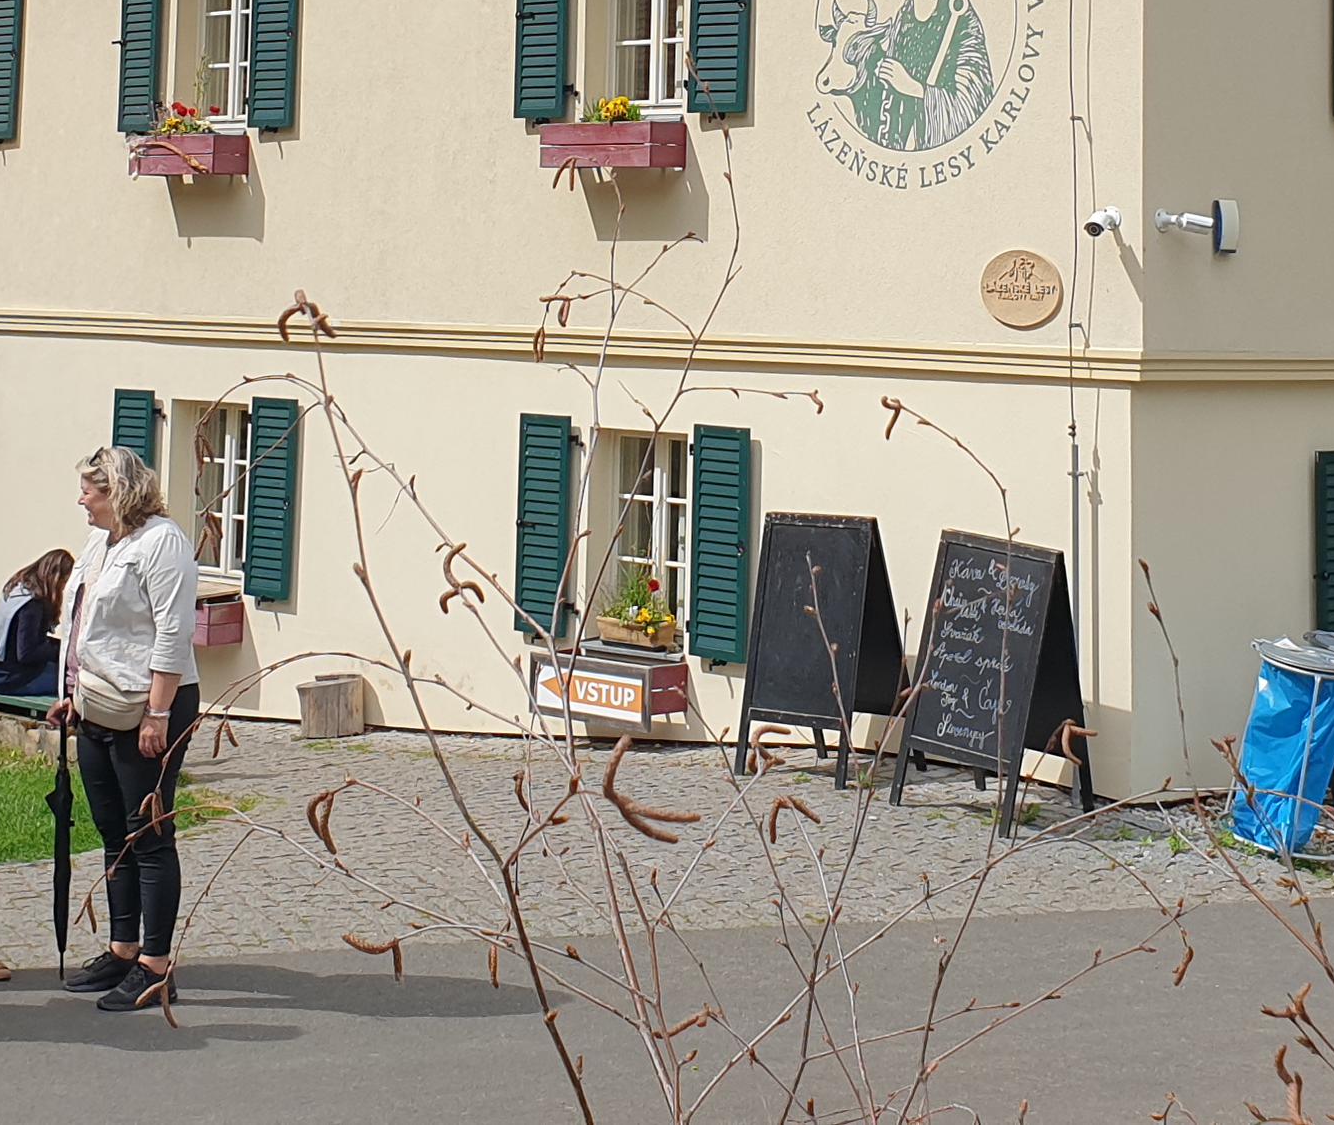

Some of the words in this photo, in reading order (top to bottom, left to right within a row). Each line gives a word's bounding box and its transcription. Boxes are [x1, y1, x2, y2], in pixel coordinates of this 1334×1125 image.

[806, 102, 909, 190] LÁZEŇSKÉ
[919, 150, 976, 189] LESY
[983, 28, 1044, 154] KARLOVY
[574, 679, 636, 708] VSTUP
